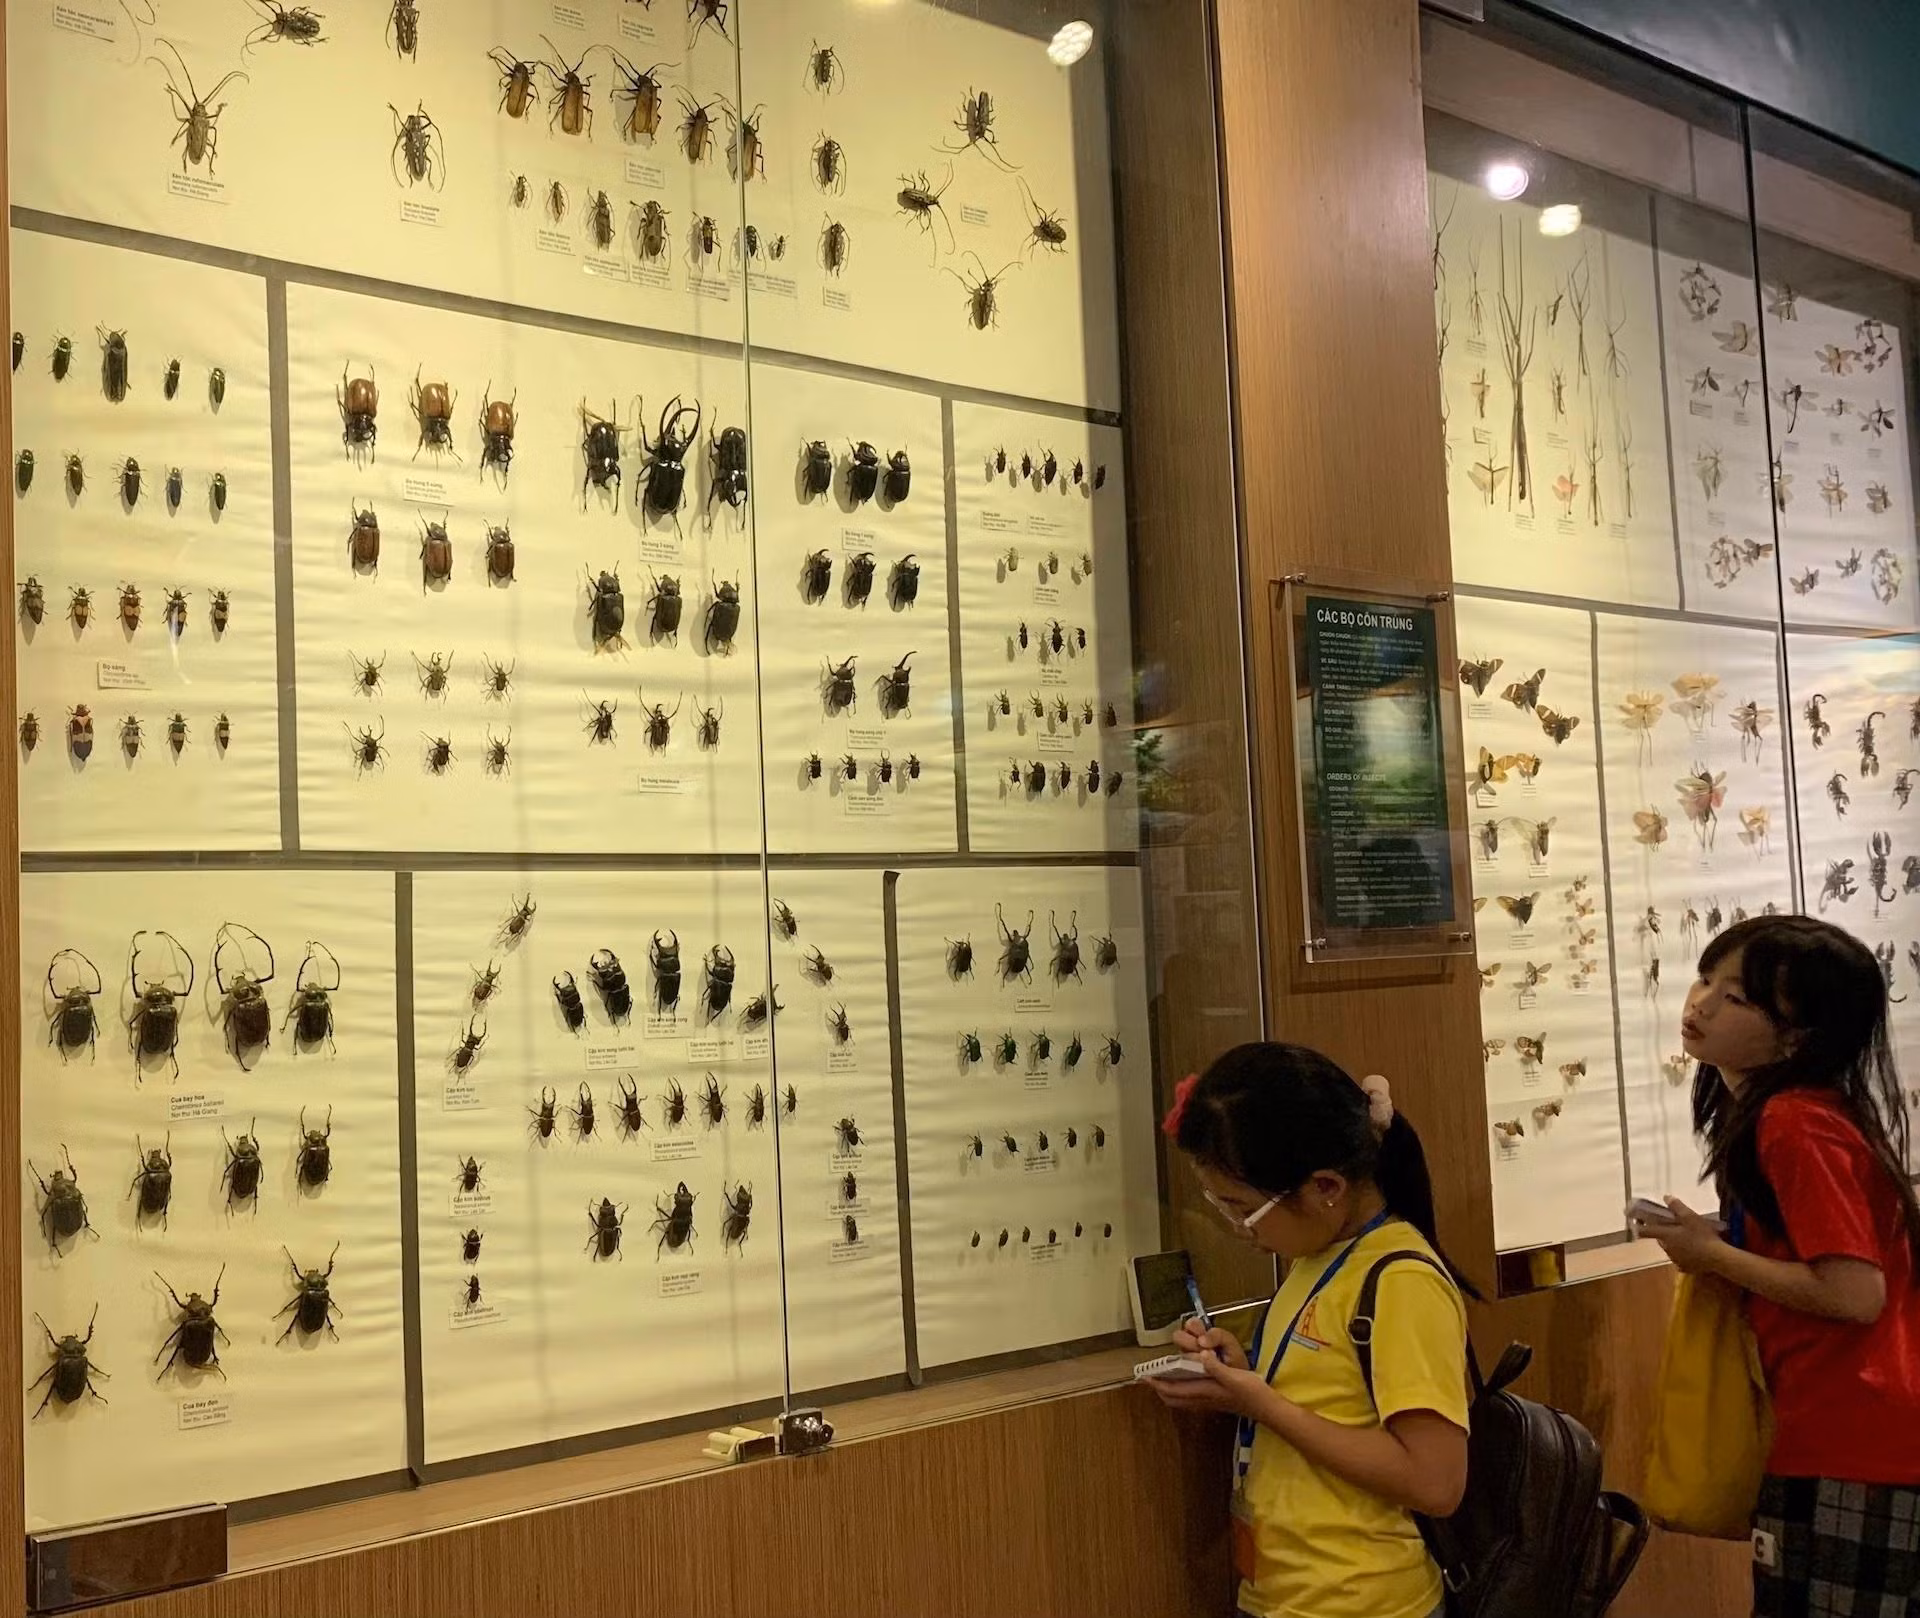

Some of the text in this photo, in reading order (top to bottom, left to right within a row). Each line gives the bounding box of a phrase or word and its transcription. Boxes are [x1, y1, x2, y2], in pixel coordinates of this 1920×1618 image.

[1316, 607, 1413, 631] CÁC BỌ CÔN TRÙNG
[1326, 773, 1352, 781] ORDERS
